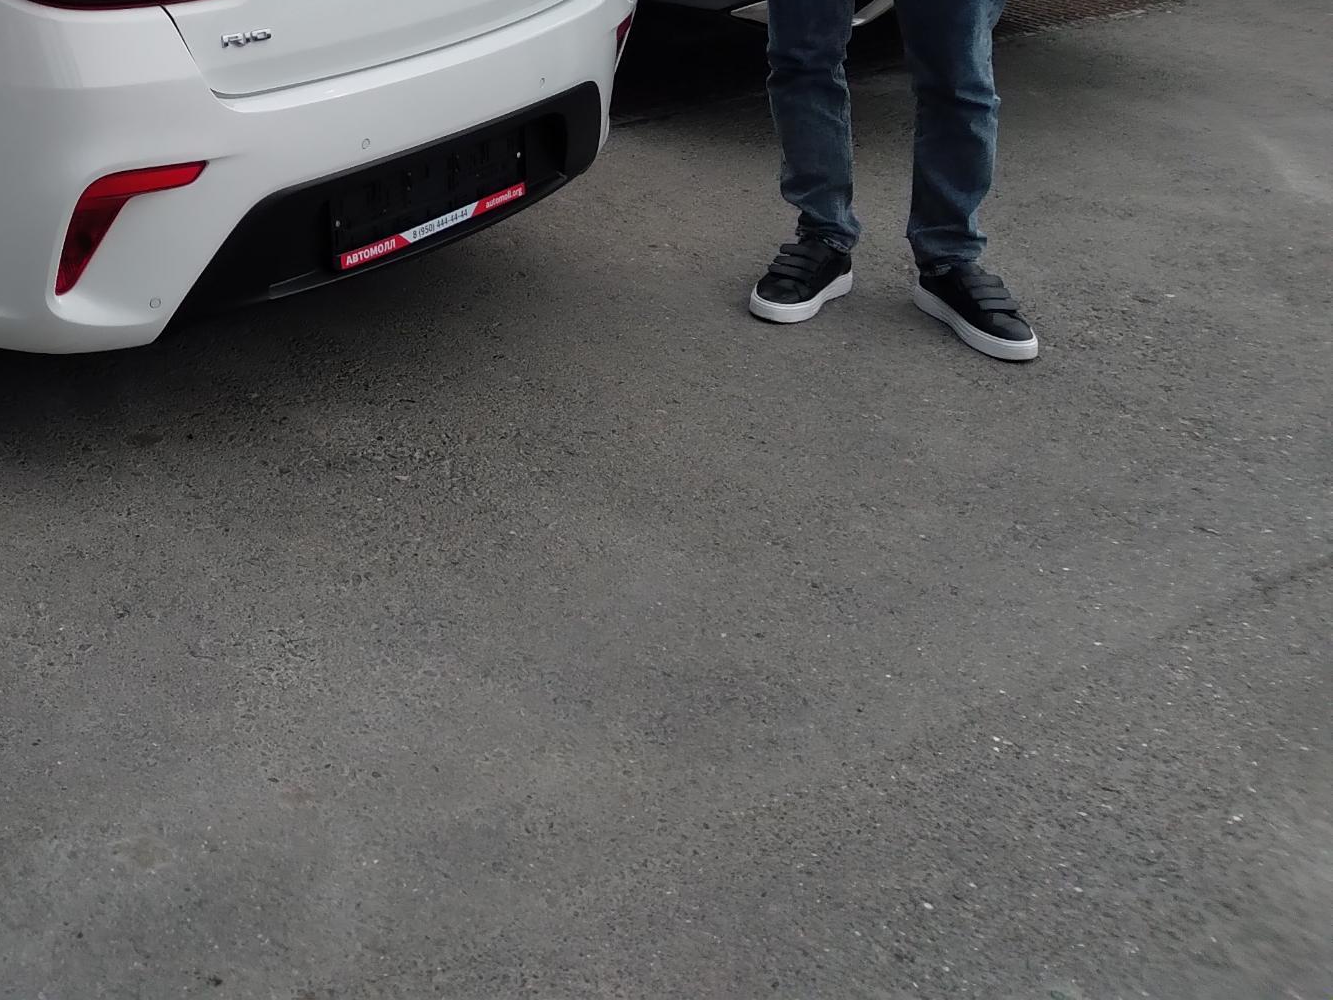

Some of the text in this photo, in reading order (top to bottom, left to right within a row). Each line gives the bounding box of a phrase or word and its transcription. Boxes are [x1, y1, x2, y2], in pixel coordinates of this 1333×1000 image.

[220, 28, 272, 49] RIO
[412, 230, 418, 239] 8
[418, 222, 435, 238] (950)
[346, 238, 396, 266] АВТОМОЛЛ
